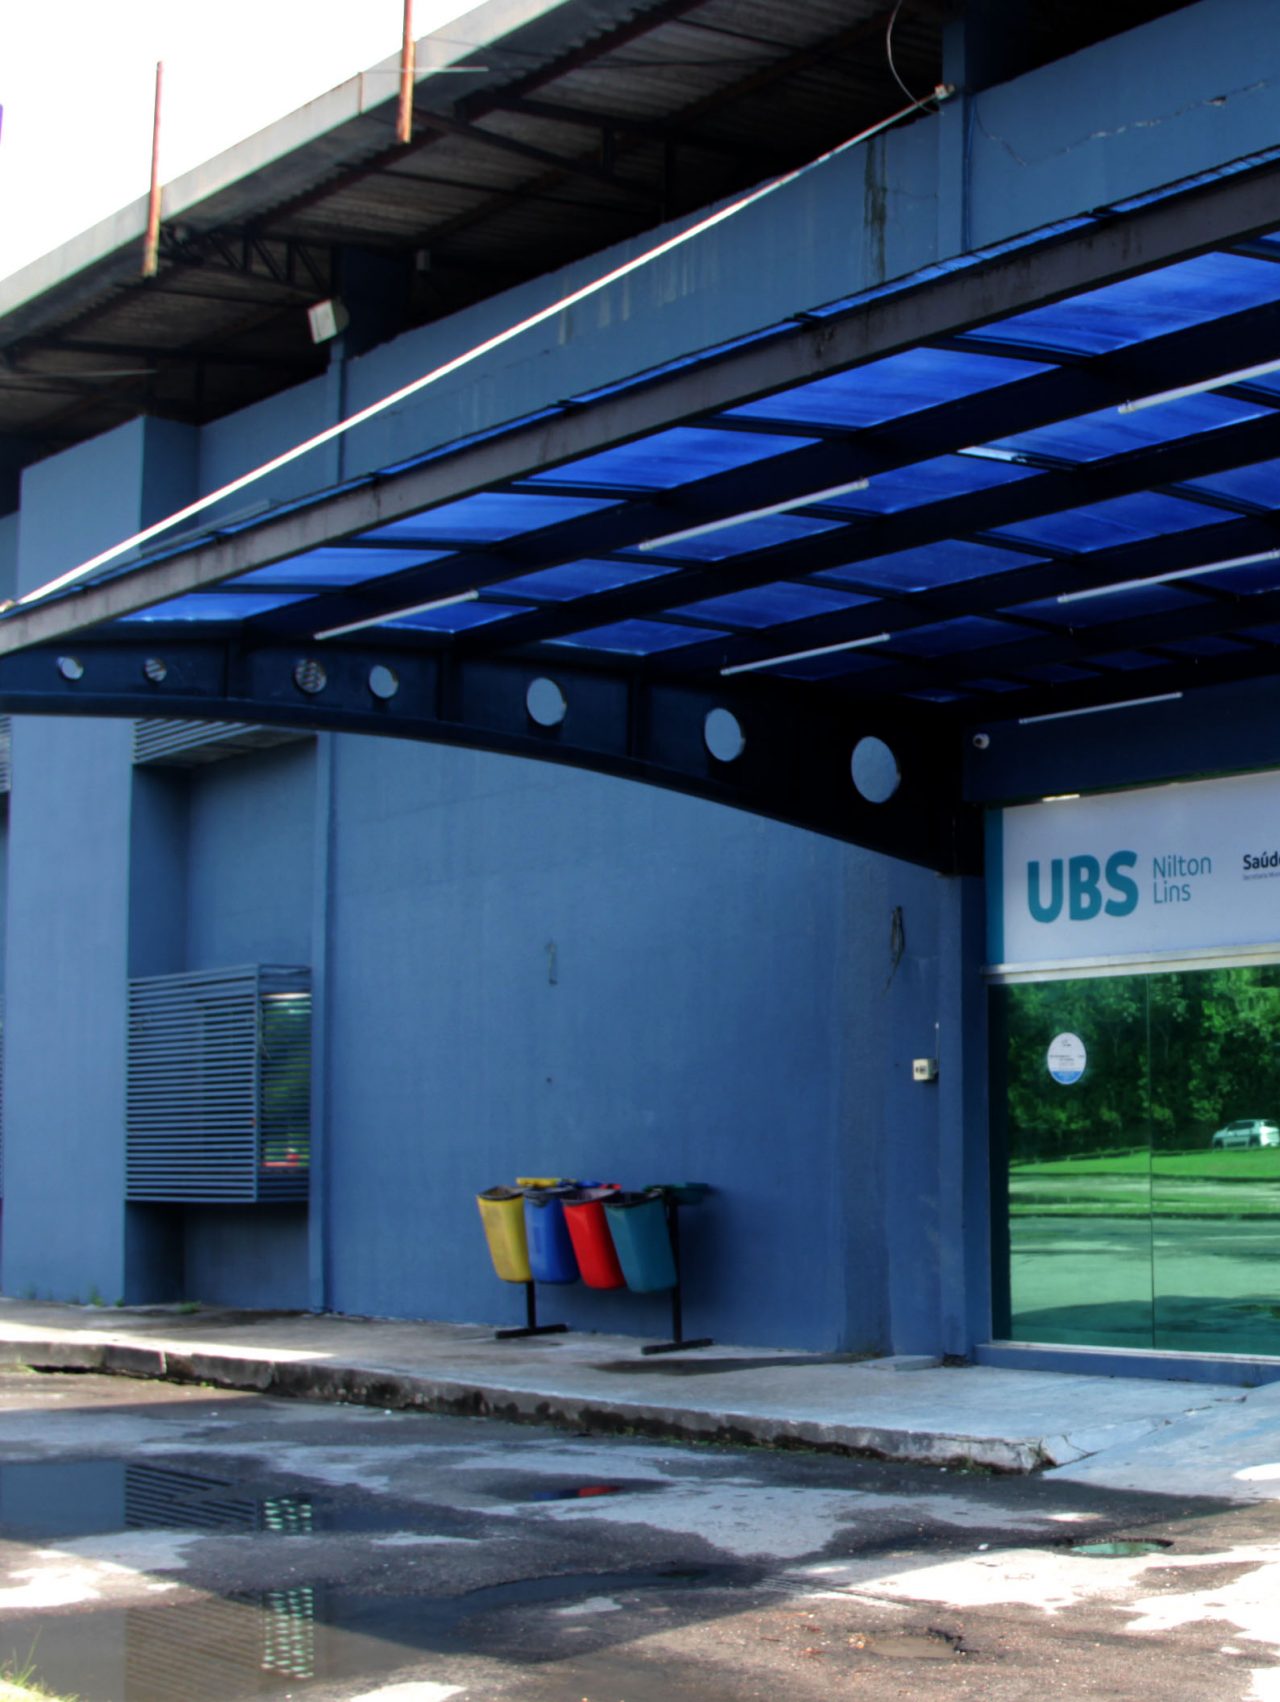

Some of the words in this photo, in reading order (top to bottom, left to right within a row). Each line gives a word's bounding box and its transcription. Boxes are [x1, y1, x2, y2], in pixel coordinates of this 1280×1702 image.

[1153, 855, 1212, 878] Nilton
[1027, 850, 1139, 923] UBS
[1153, 881, 1191, 904] Lins
